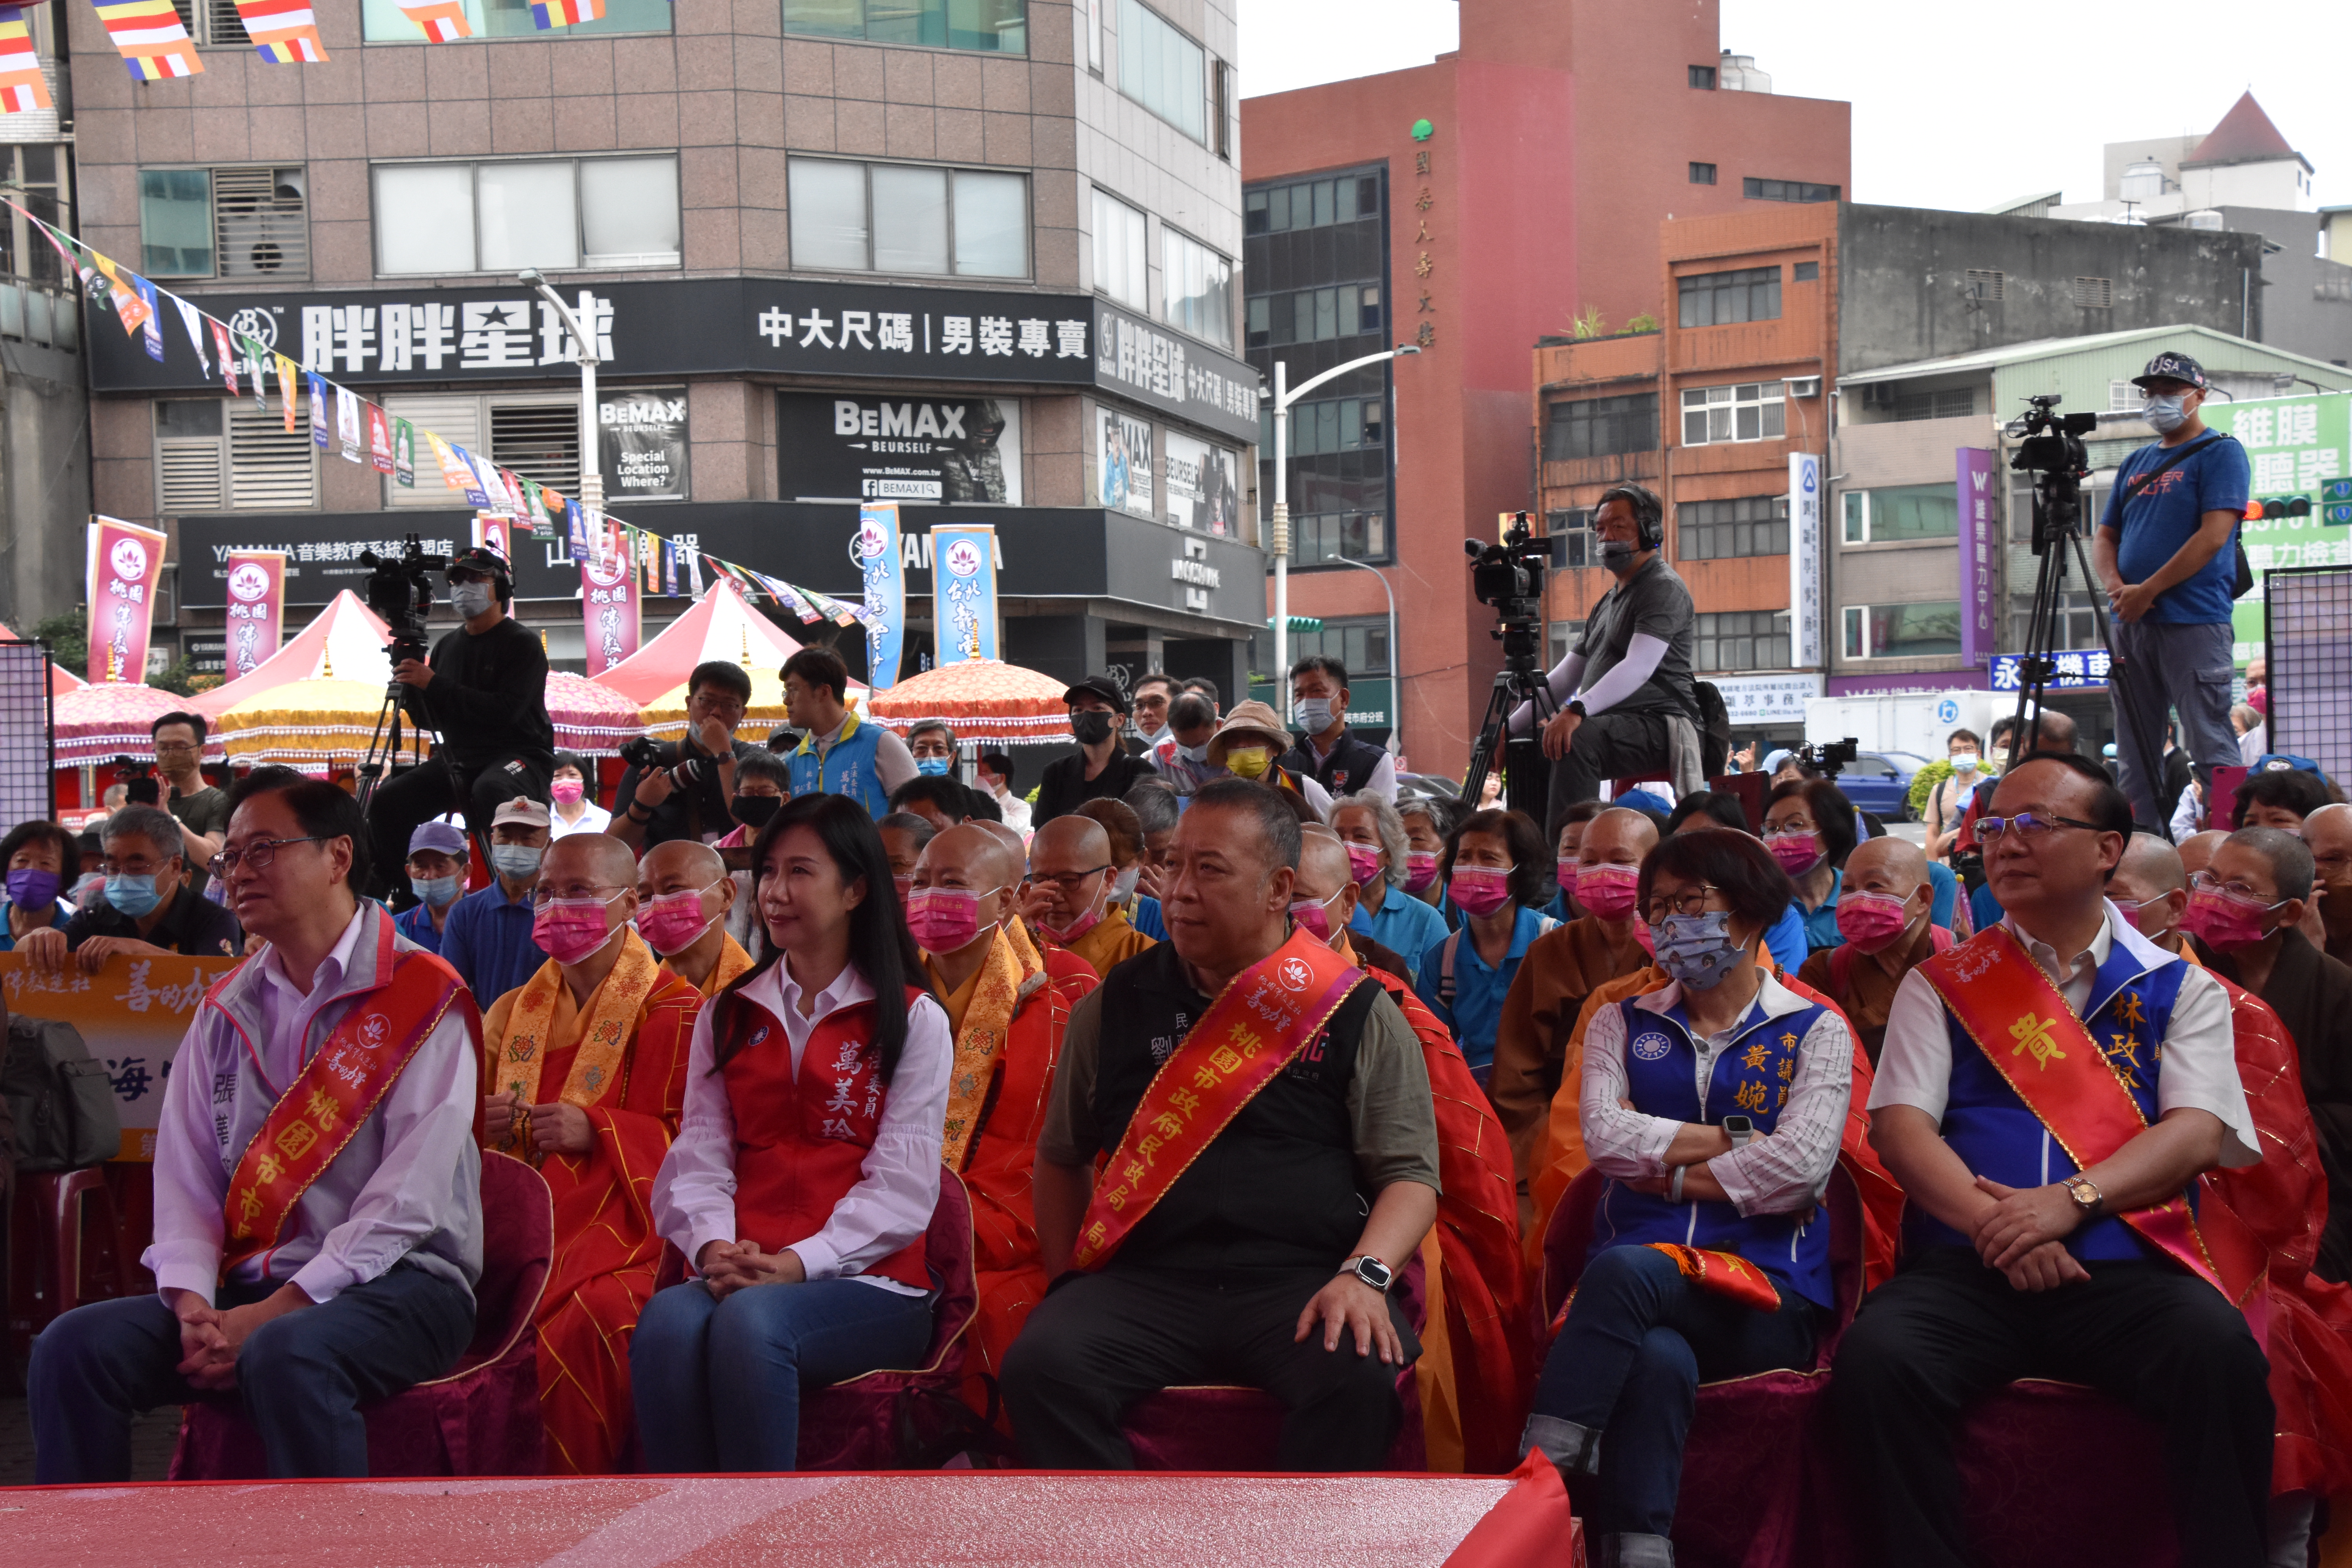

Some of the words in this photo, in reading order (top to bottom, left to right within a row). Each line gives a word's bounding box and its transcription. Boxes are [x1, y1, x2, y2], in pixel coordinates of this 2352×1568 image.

[301, 298, 615, 373] 胖胖星球
[759, 306, 913, 352] 中大尺碼
[942, 316, 1088, 359] 男裝專賣
[1118, 318, 1185, 403] 胖胖星球
[2150, 357, 2179, 375] USA
[621, 450, 665, 464] Special
[872, 441, 932, 454] BEURSELF
[617, 463, 669, 475] Location
[621, 475, 666, 487] Where?
[1972, 472, 1987, 491] W
[2127, 471, 2184, 486] NEER
[883, 483, 919, 494] BEMAX
[298, 539, 453, 563] 音樂教育系統盟店
[110, 578, 144, 604] 桃園
[590, 585, 627, 604] 桃園
[947, 578, 982, 602] 台北
[229, 602, 268, 621] 桃園
[236, 623, 258, 678] 佛教
[1994, 652, 2111, 689] 永機車
[1245, 986, 1291, 1033] 善的力量
[2008, 1012, 2066, 1072] 貴
[327, 1049, 367, 1089] 善的力量
[862, 1042, 884, 1119] 法委員
[1733, 1044, 1772, 1114] 黃婉
[1776, 1032, 1798, 1108] 市議員
[1105, 1022, 1263, 1212] 桃園市政府民政局
